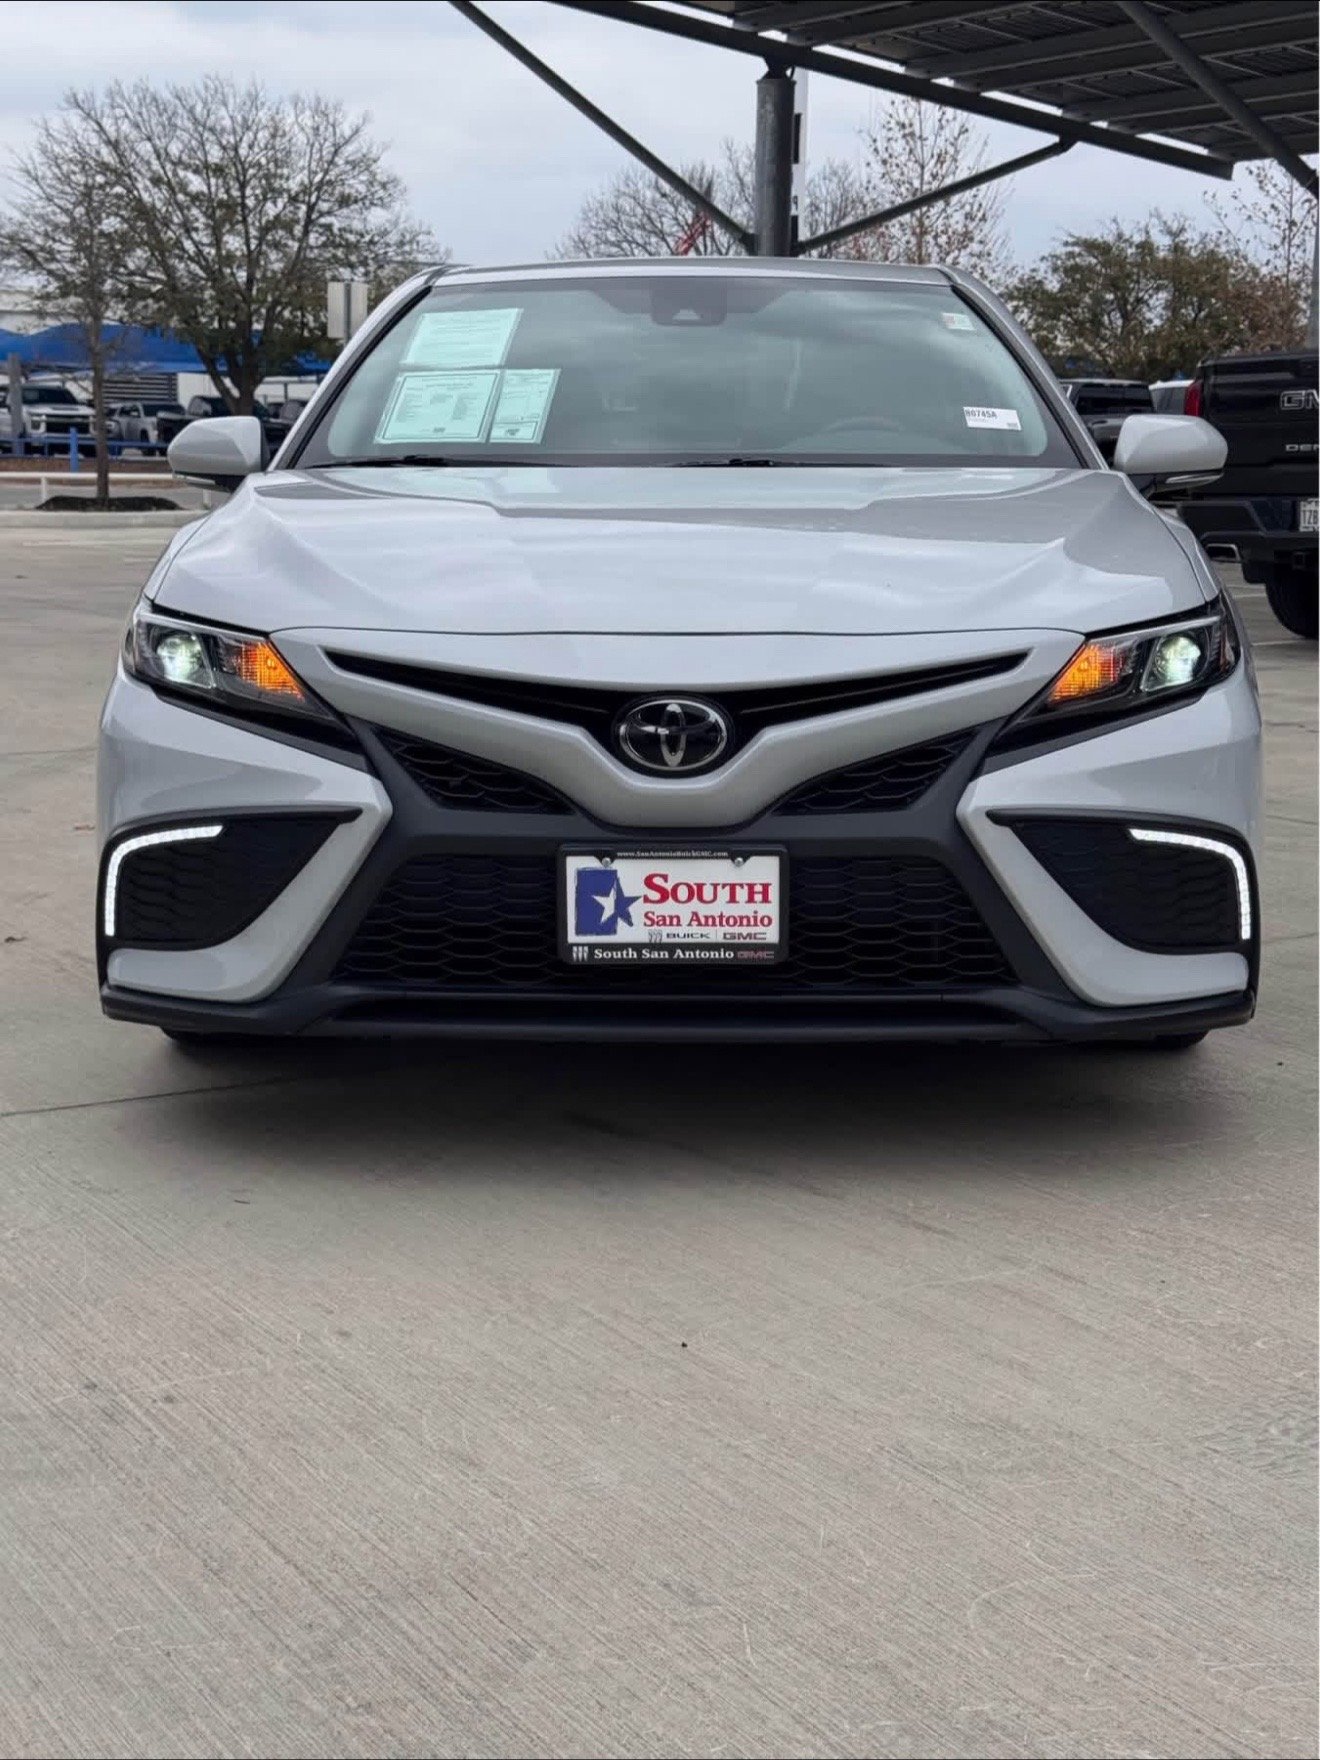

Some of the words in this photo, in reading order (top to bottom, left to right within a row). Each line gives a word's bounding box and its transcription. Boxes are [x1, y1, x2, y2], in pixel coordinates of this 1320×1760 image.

[643, 911, 682, 927] San
[687, 911, 773, 927] Antonio
[666, 931, 711, 939] BUICK
[722, 931, 767, 941] GMC
[593, 948, 638, 959] South
[641, 948, 669, 959] San
[673, 948, 735, 959] Antonio
[736, 951, 775, 959] GMC
